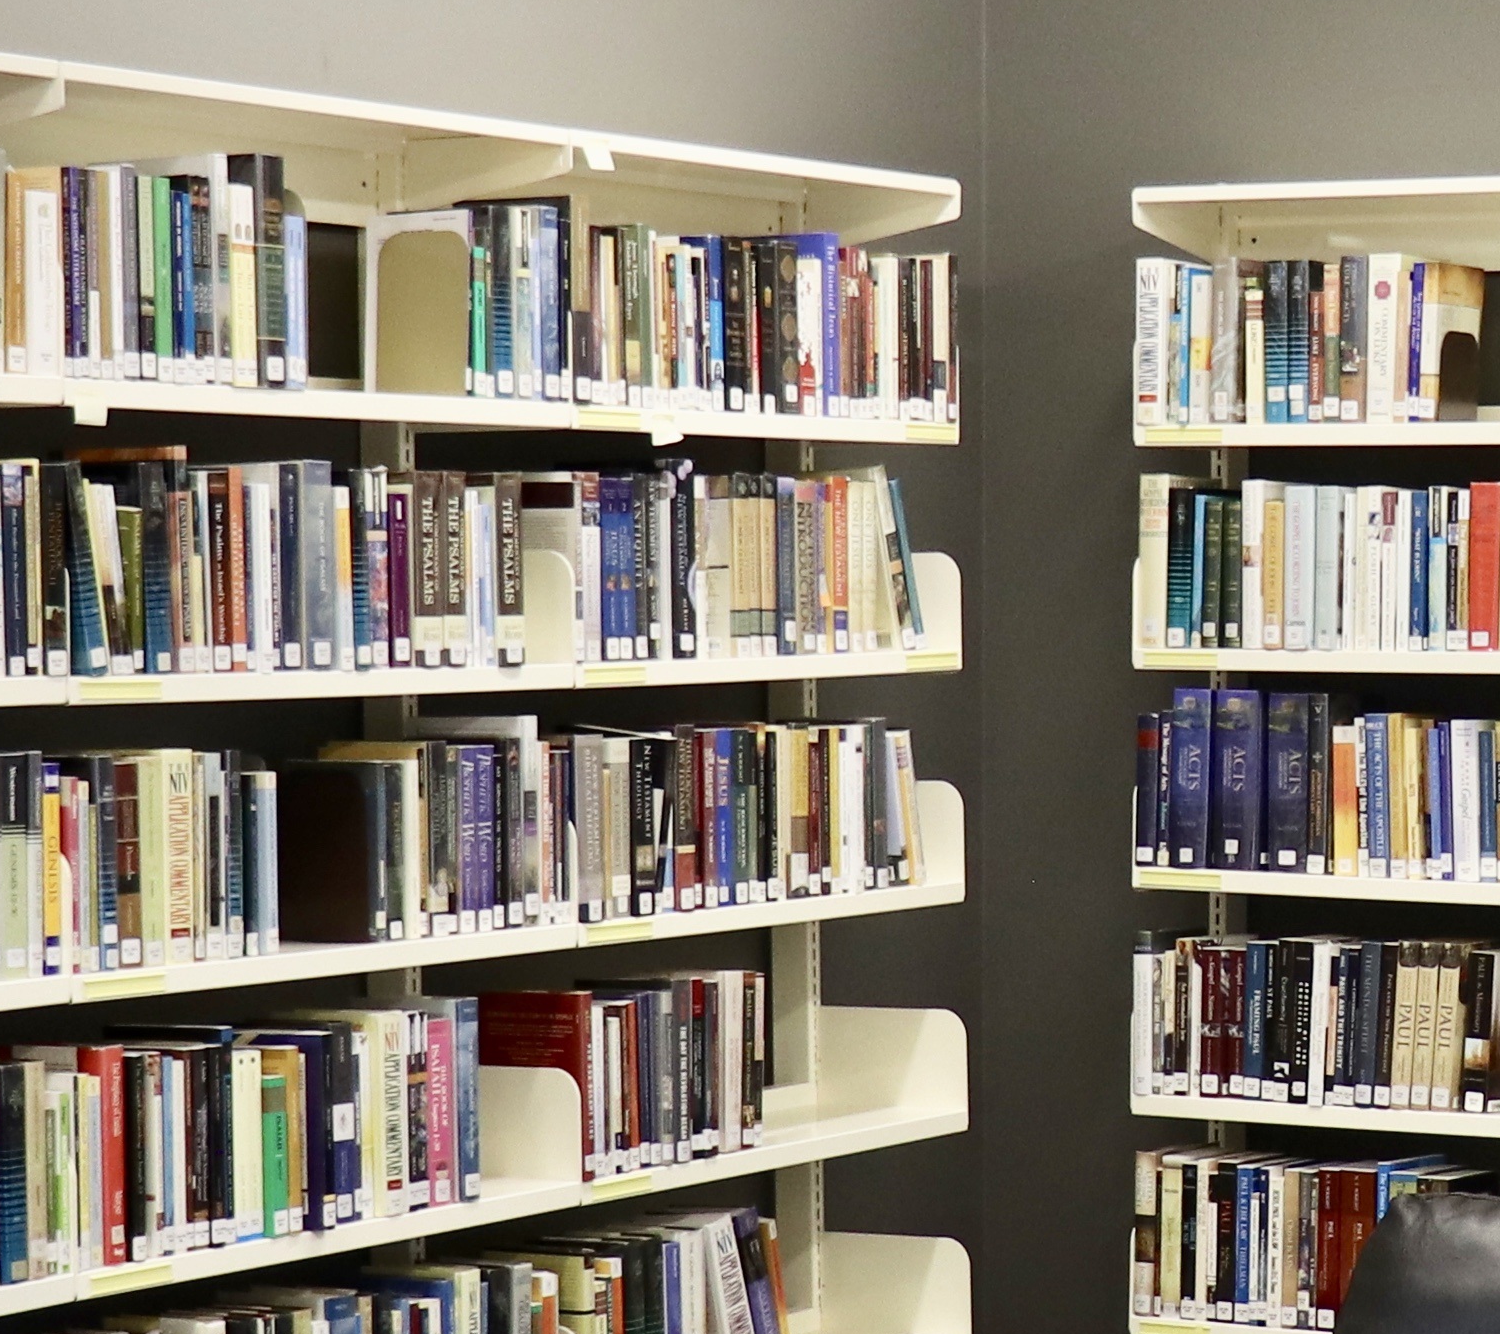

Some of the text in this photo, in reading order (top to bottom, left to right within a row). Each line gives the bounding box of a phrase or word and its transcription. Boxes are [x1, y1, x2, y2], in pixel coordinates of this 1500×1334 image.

[826, 246, 836, 339] The Historical Jesus
[214, 502, 225, 560] The Psalms
[422, 497, 435, 605] THE PSALMS
[796, 502, 808, 632] INTRODUCTION
[804, 503, 816, 624] NEW TESTAMENT
[635, 762, 644, 821] THEOLOGY
[643, 745, 652, 838] NEW TESTAMENT
[717, 756, 729, 806] JESUS
[1287, 748, 1302, 795] ACTS
[48, 835, 59, 904] GENESIS
[169, 795, 189, 926] APPLICATION COMMENTARY
[1438, 1004, 1453, 1050] PAUL
